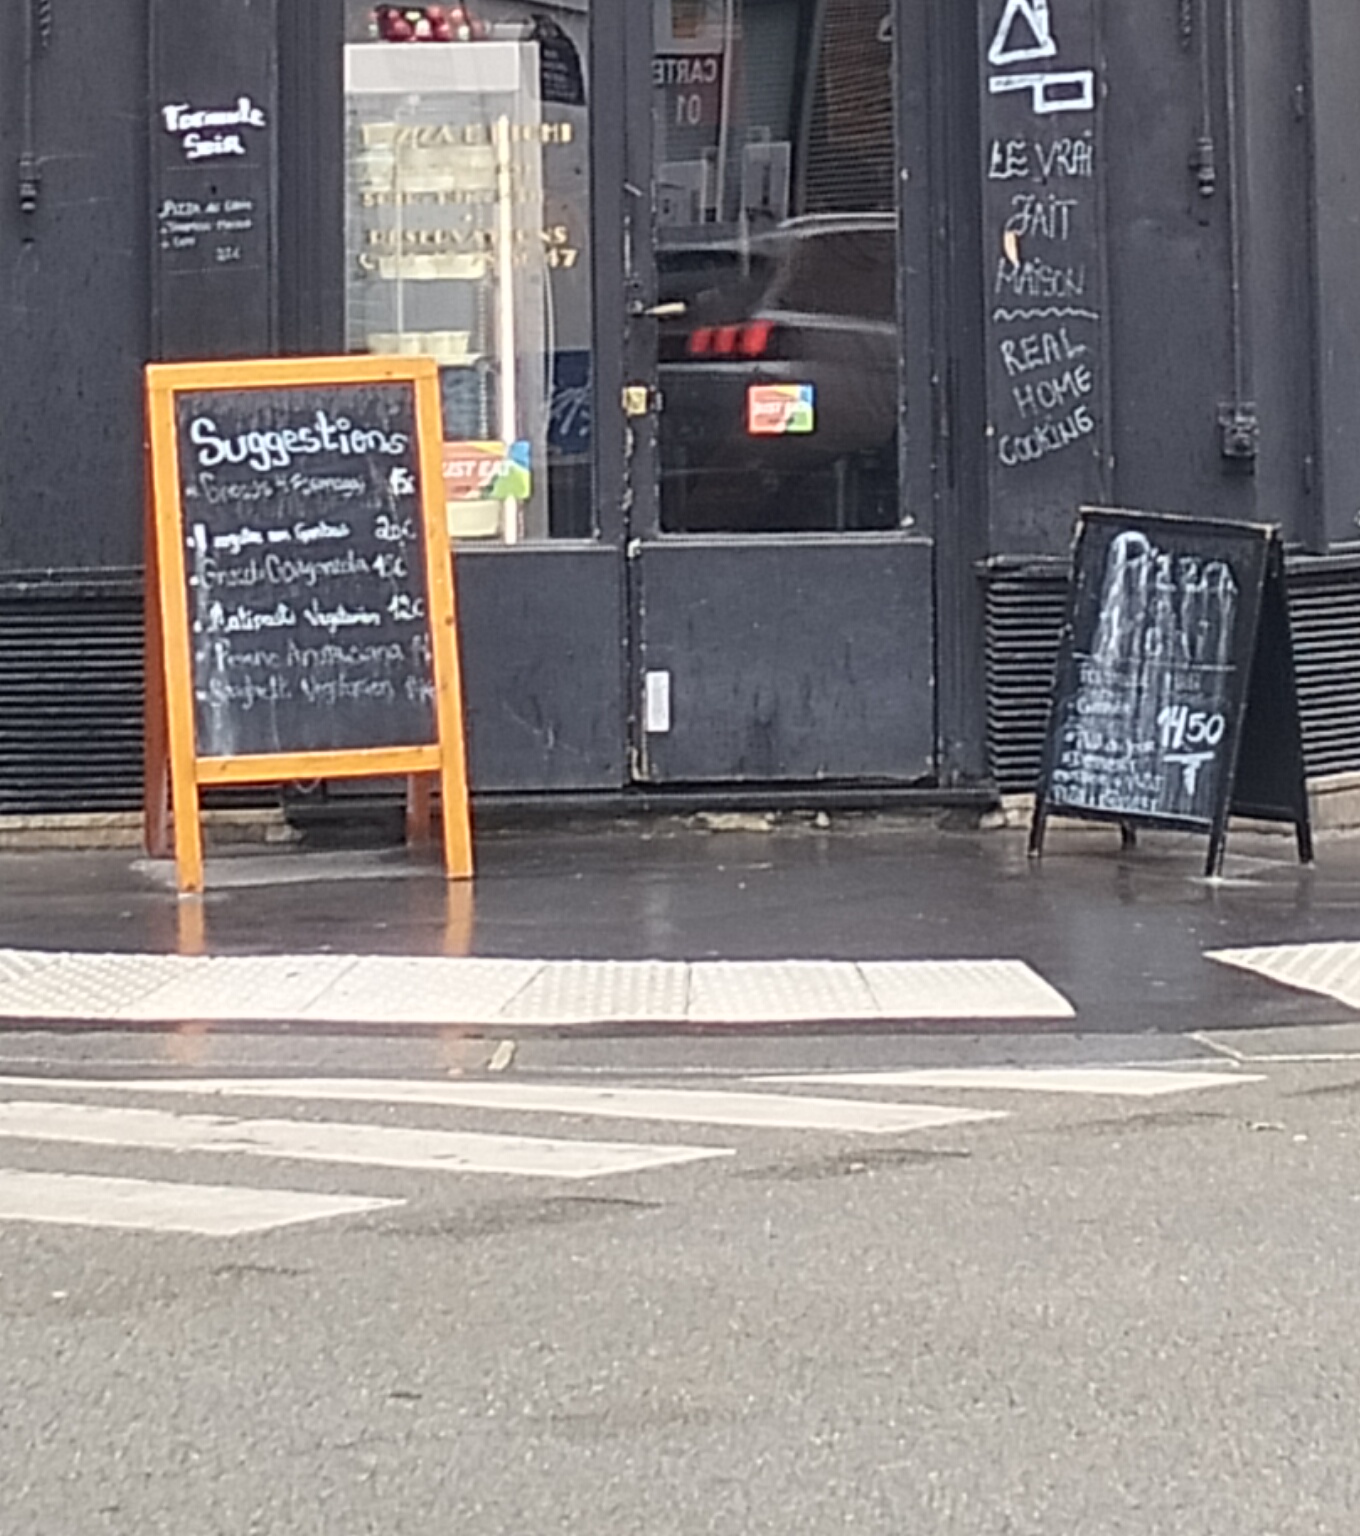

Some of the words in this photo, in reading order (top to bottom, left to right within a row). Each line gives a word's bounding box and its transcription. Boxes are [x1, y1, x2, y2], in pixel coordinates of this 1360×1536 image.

[988, 138, 1029, 178] LE
[999, 326, 1087, 376] REAL
[1013, 364, 1093, 419] HOME
[191, 409, 408, 472] Suggestions
[442, 462, 476, 478] UST
